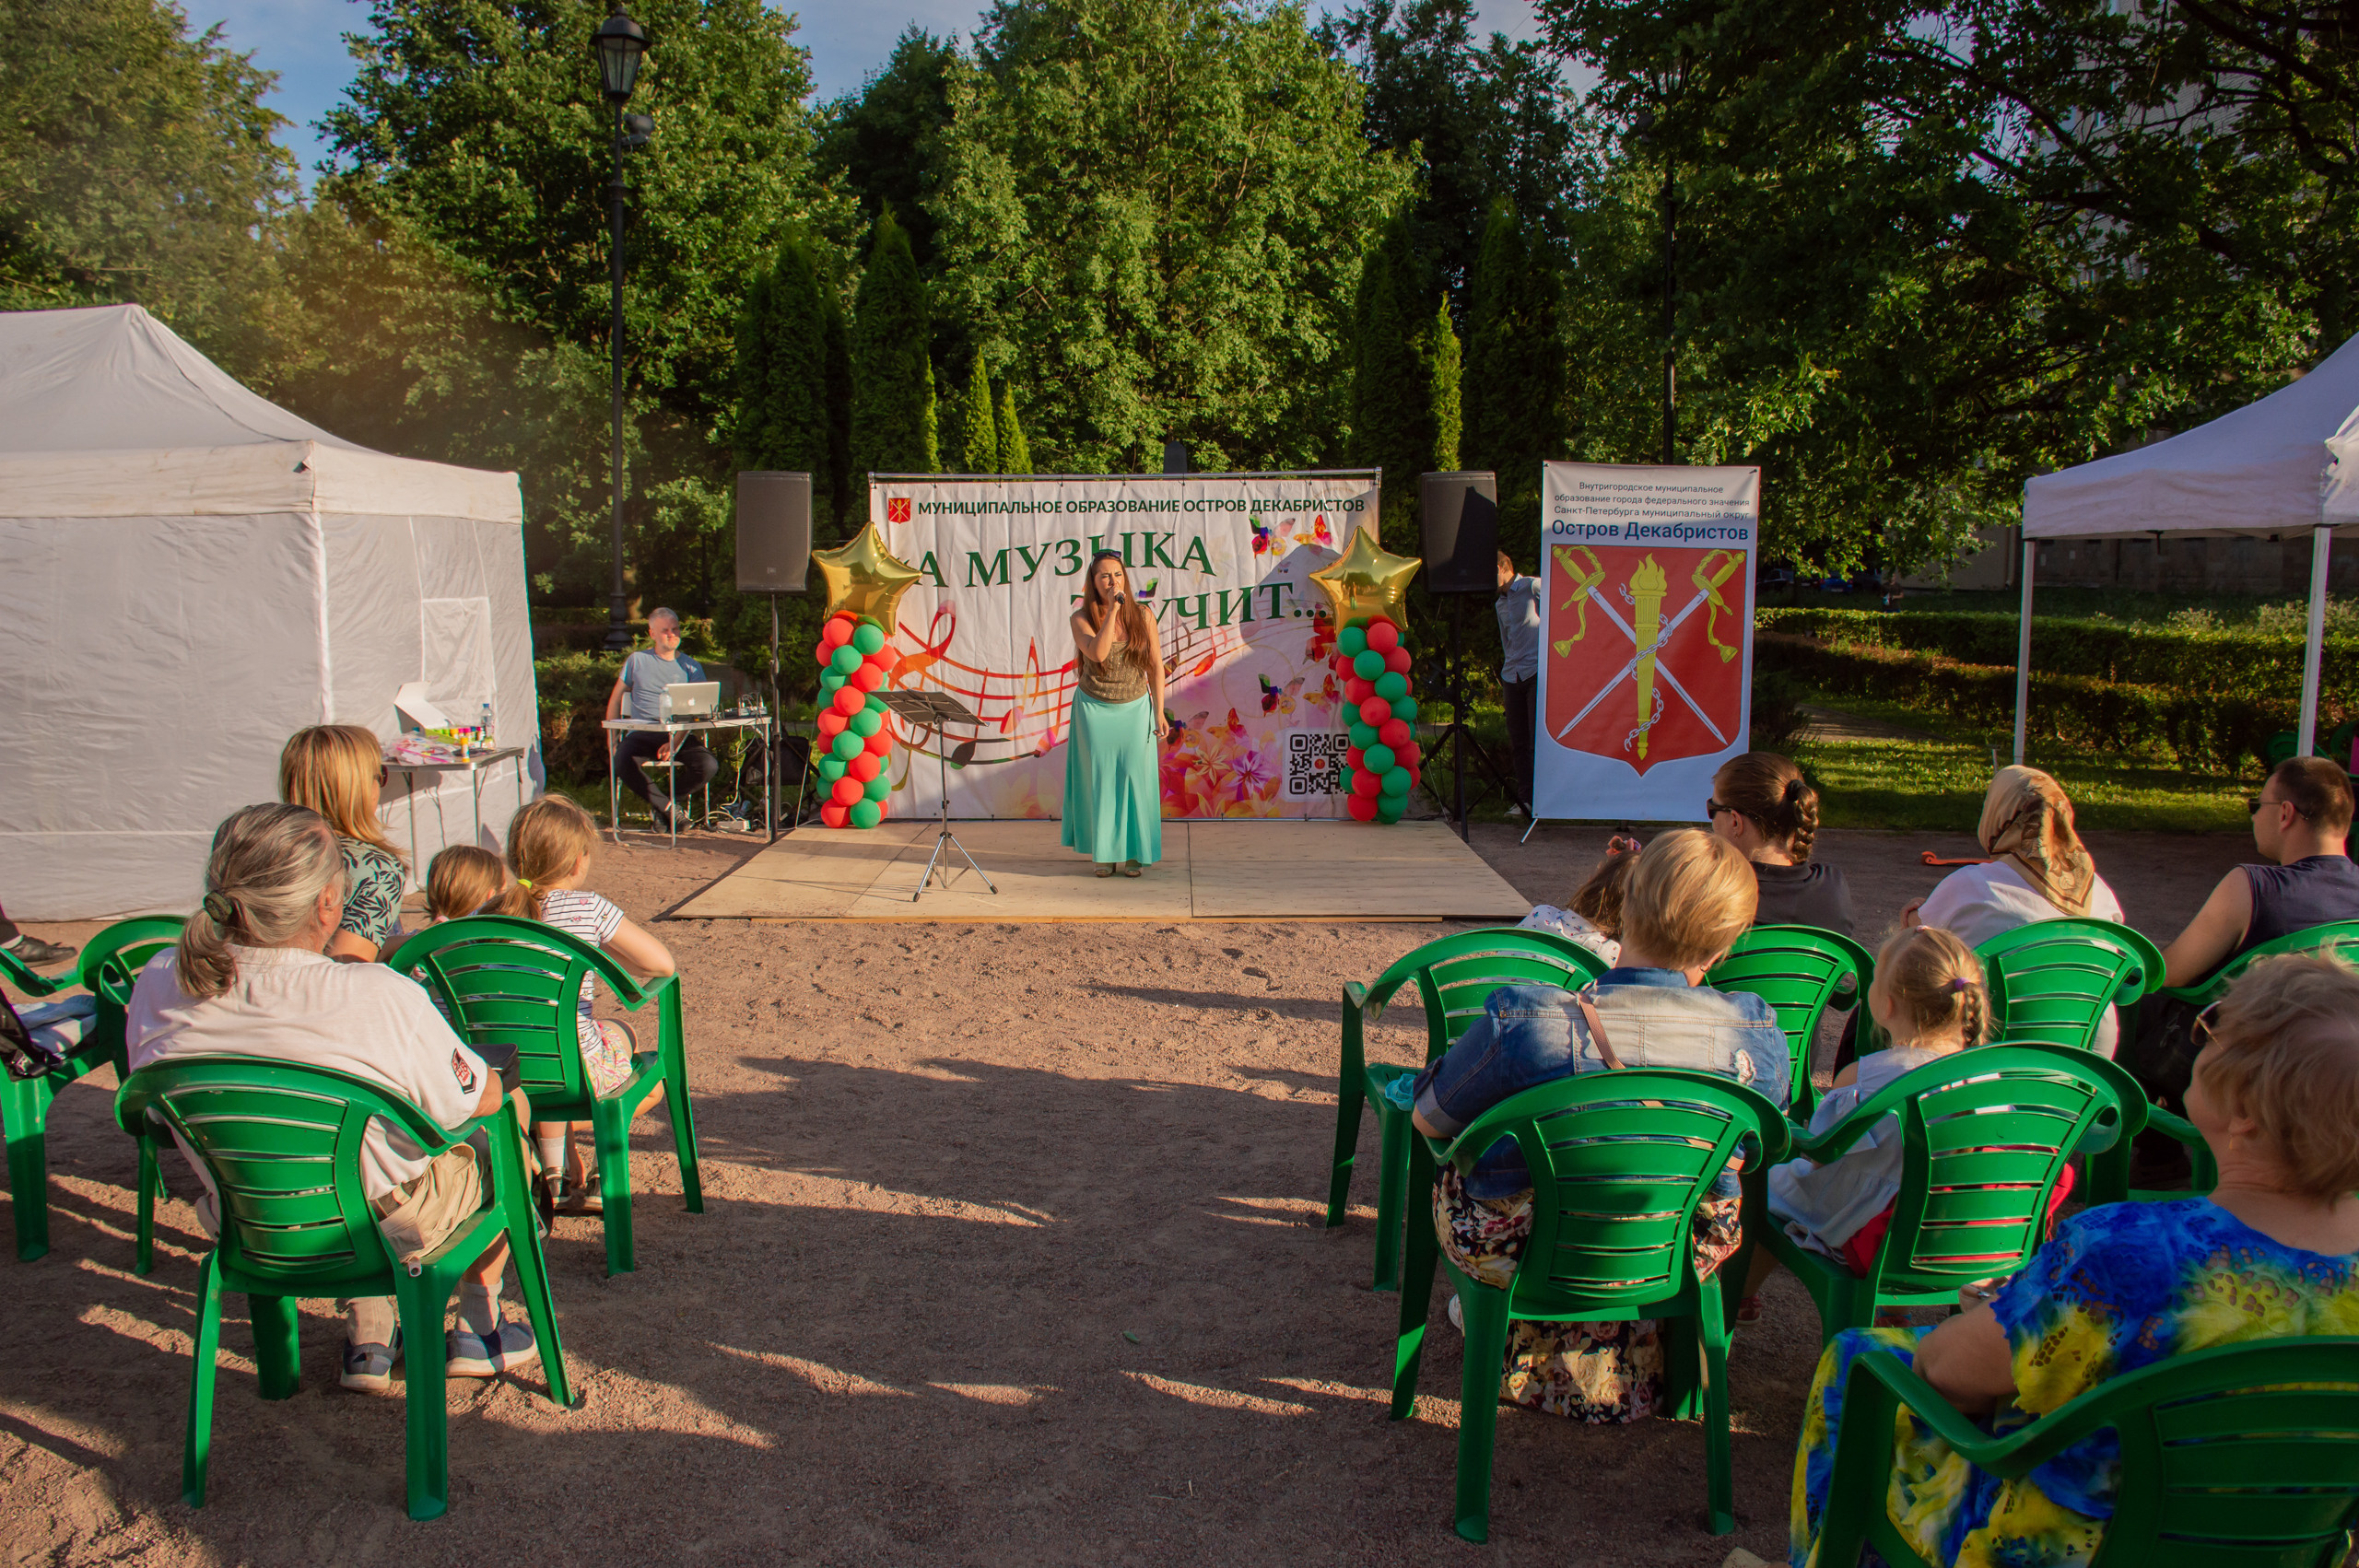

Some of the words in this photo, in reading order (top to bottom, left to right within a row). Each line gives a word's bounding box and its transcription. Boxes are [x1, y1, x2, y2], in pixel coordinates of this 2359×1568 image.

[1579, 482, 1654, 492] Внутригородское
[1655, 485, 1724, 494] муниципальное
[918, 500, 1062, 517] МУНИЦИПАЛЬНОЕ
[1065, 499, 1180, 514] ОБРАЗОВАНИЕ
[1183, 498, 1247, 513] ОСТРОВ
[1250, 498, 1366, 514] ДЕКАБРИСТОВ
[1555, 494, 1611, 503] образование
[1613, 497, 1643, 505] города
[1644, 496, 1708, 506] федерального
[1708, 498, 1750, 507] значения
[1554, 506, 1640, 518] Санкт-Петербурга
[1641, 509, 1721, 519] муниципальный
[1722, 511, 1750, 521] округ
[1552, 519, 1619, 540] Остров
[1625, 521, 1749, 543] Декабристов
